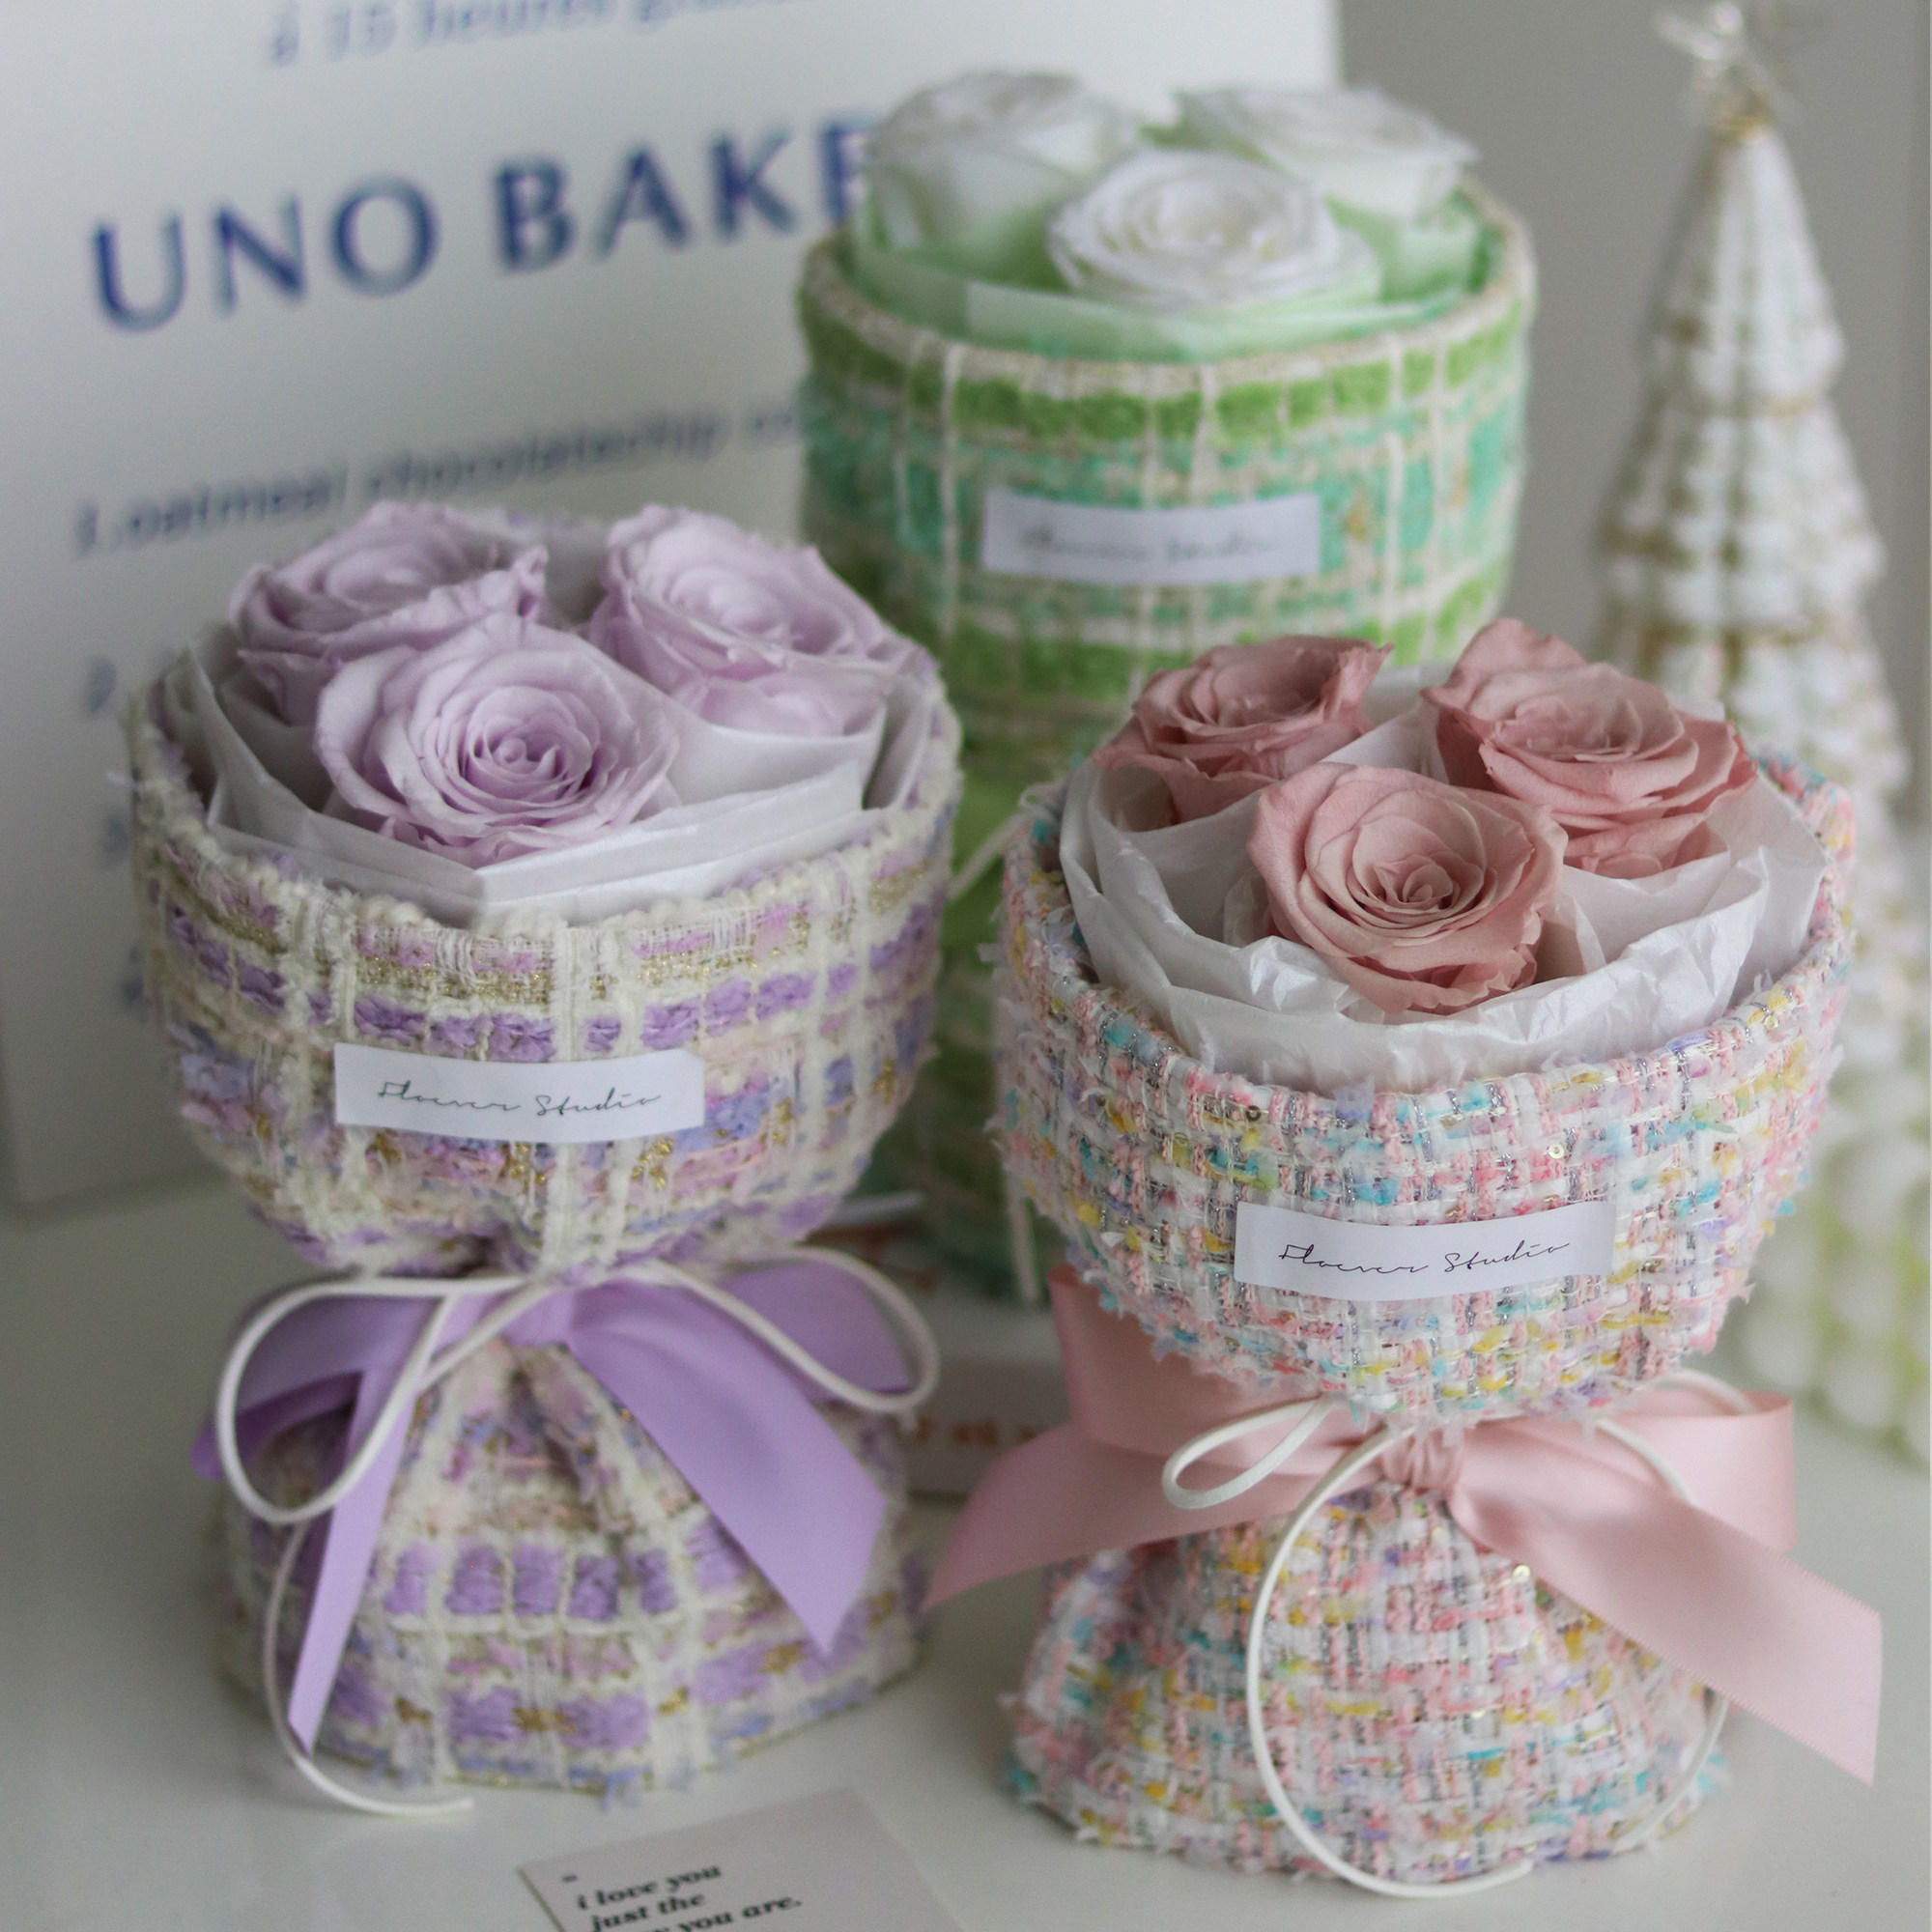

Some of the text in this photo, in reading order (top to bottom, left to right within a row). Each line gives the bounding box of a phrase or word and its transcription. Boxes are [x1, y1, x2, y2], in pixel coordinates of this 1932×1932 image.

[92, 170, 441, 333] UNO
[377, 1079, 664, 1117] Flower Studio
[1277, 1239, 1571, 1275] Flower Studio
[577, 1865, 723, 1911] i love you
[590, 1893, 705, 1932] just the
[679, 1896, 804, 1932] you are.
